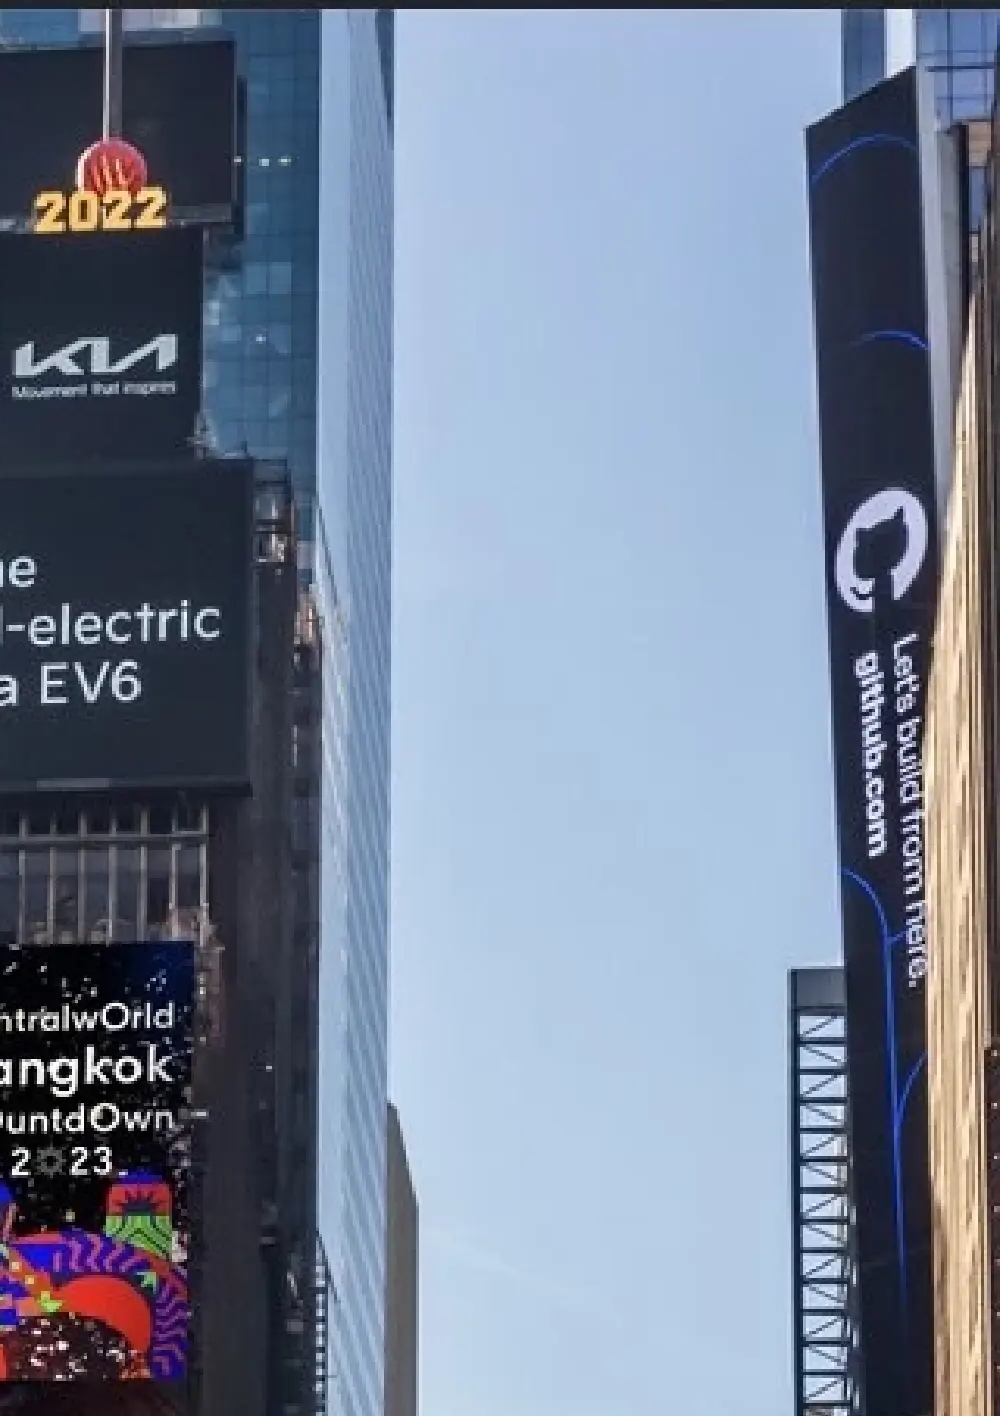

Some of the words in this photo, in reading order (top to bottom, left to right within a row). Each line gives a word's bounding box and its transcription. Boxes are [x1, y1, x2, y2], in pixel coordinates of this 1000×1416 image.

[34, 186, 168, 234] 2022
[40, 658, 143, 705] EV6
[893, 633, 920, 712] Let's
[854, 652, 887, 857] github.com
[897, 716, 922, 803] build
[901, 809, 925, 894] from
